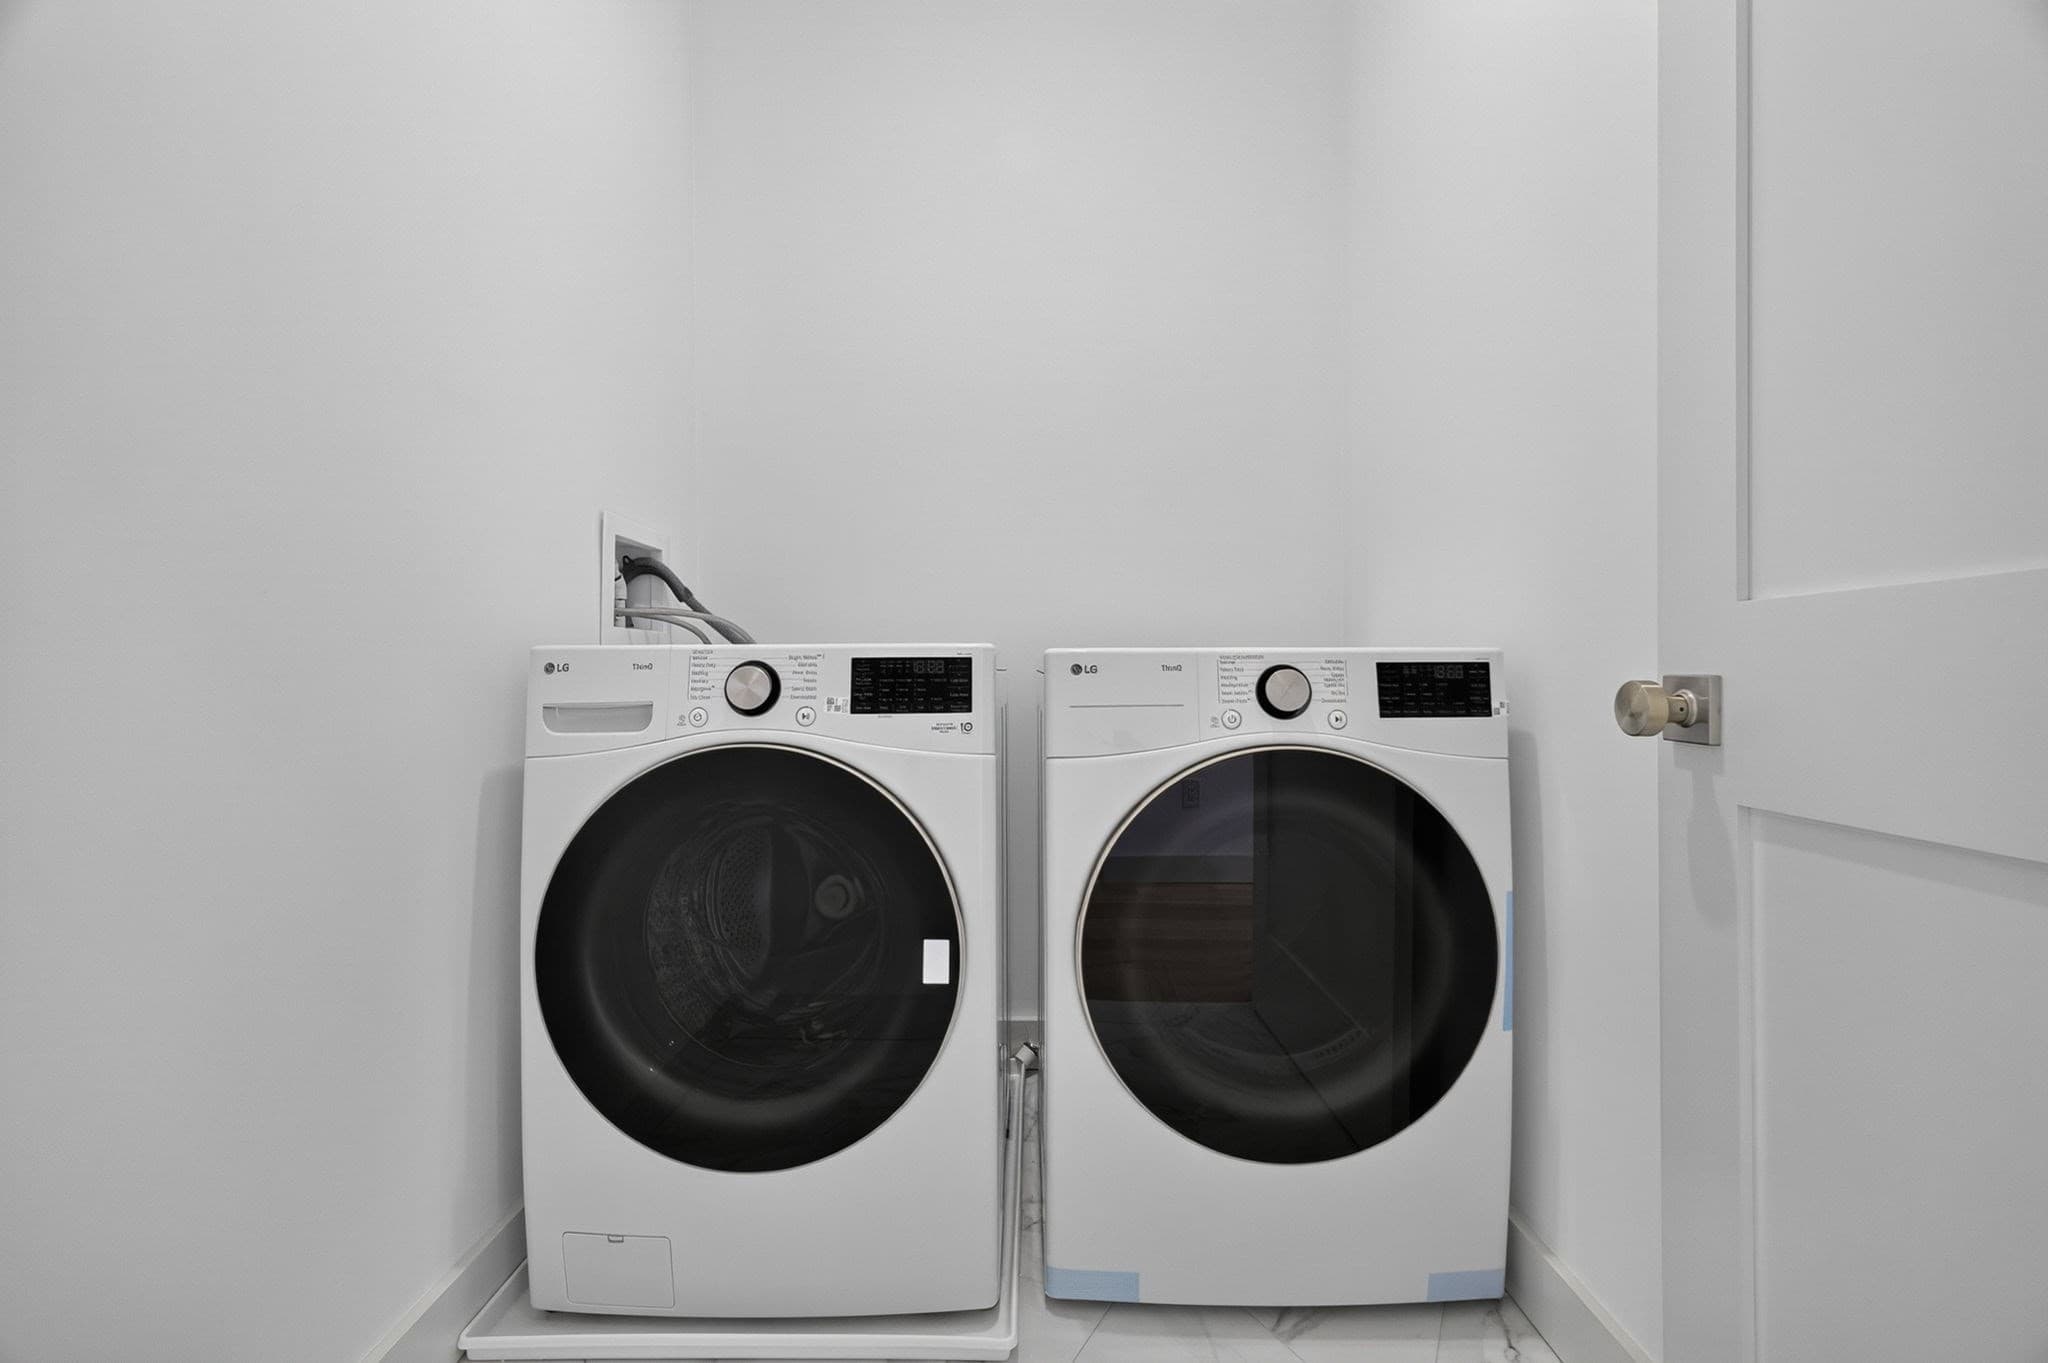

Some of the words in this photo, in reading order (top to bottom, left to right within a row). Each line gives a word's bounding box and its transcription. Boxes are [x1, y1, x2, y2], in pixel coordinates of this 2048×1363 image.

[557, 663, 570, 673] LG
[1084, 664, 1098, 674] LG
[1161, 664, 1183, 672] ThinQ
